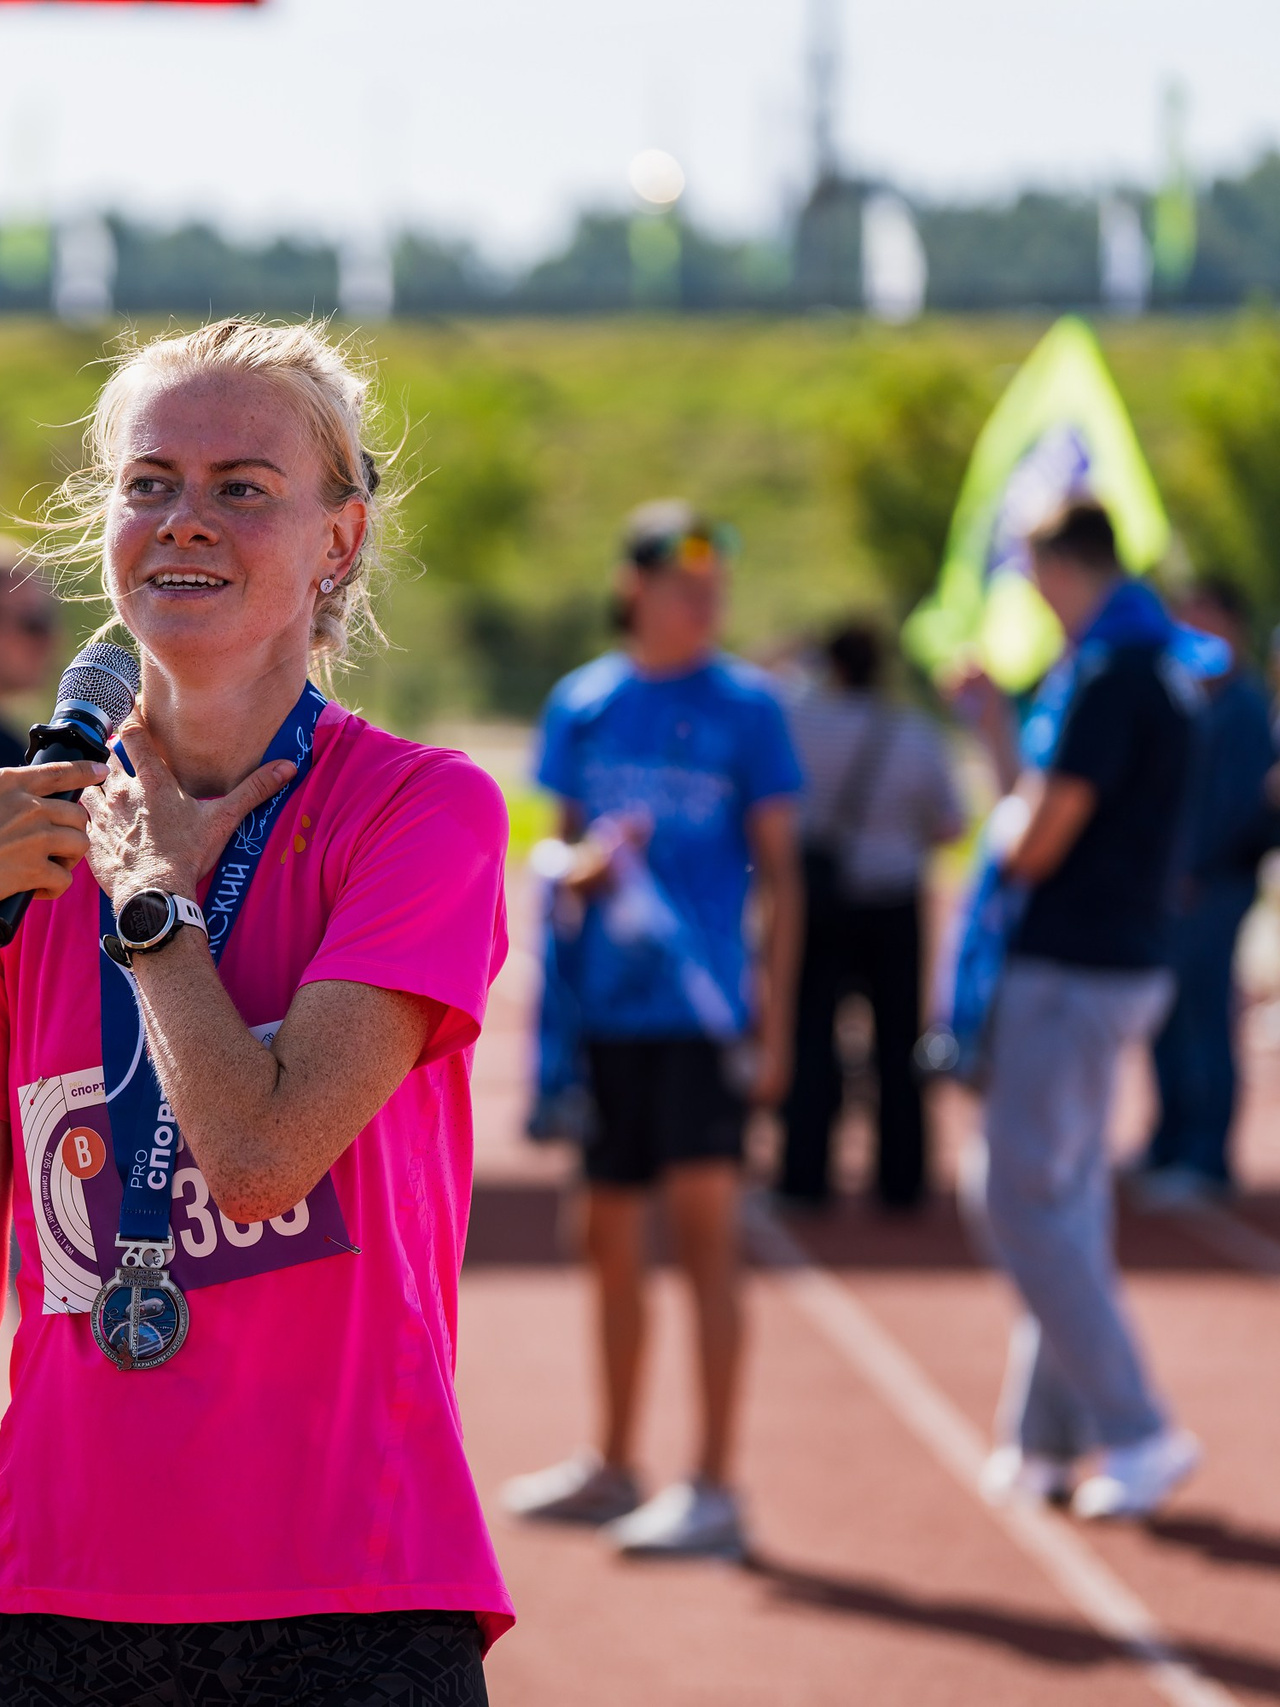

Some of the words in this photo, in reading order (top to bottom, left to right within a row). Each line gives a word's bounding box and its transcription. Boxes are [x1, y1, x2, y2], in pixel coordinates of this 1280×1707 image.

[43, 1151, 53, 1169] 9:05
[130, 1149, 147, 1188] PRO
[44, 1201, 55, 1223] забег
[64, 1244, 75, 1256] км
[121, 1246, 166, 1269] 60
